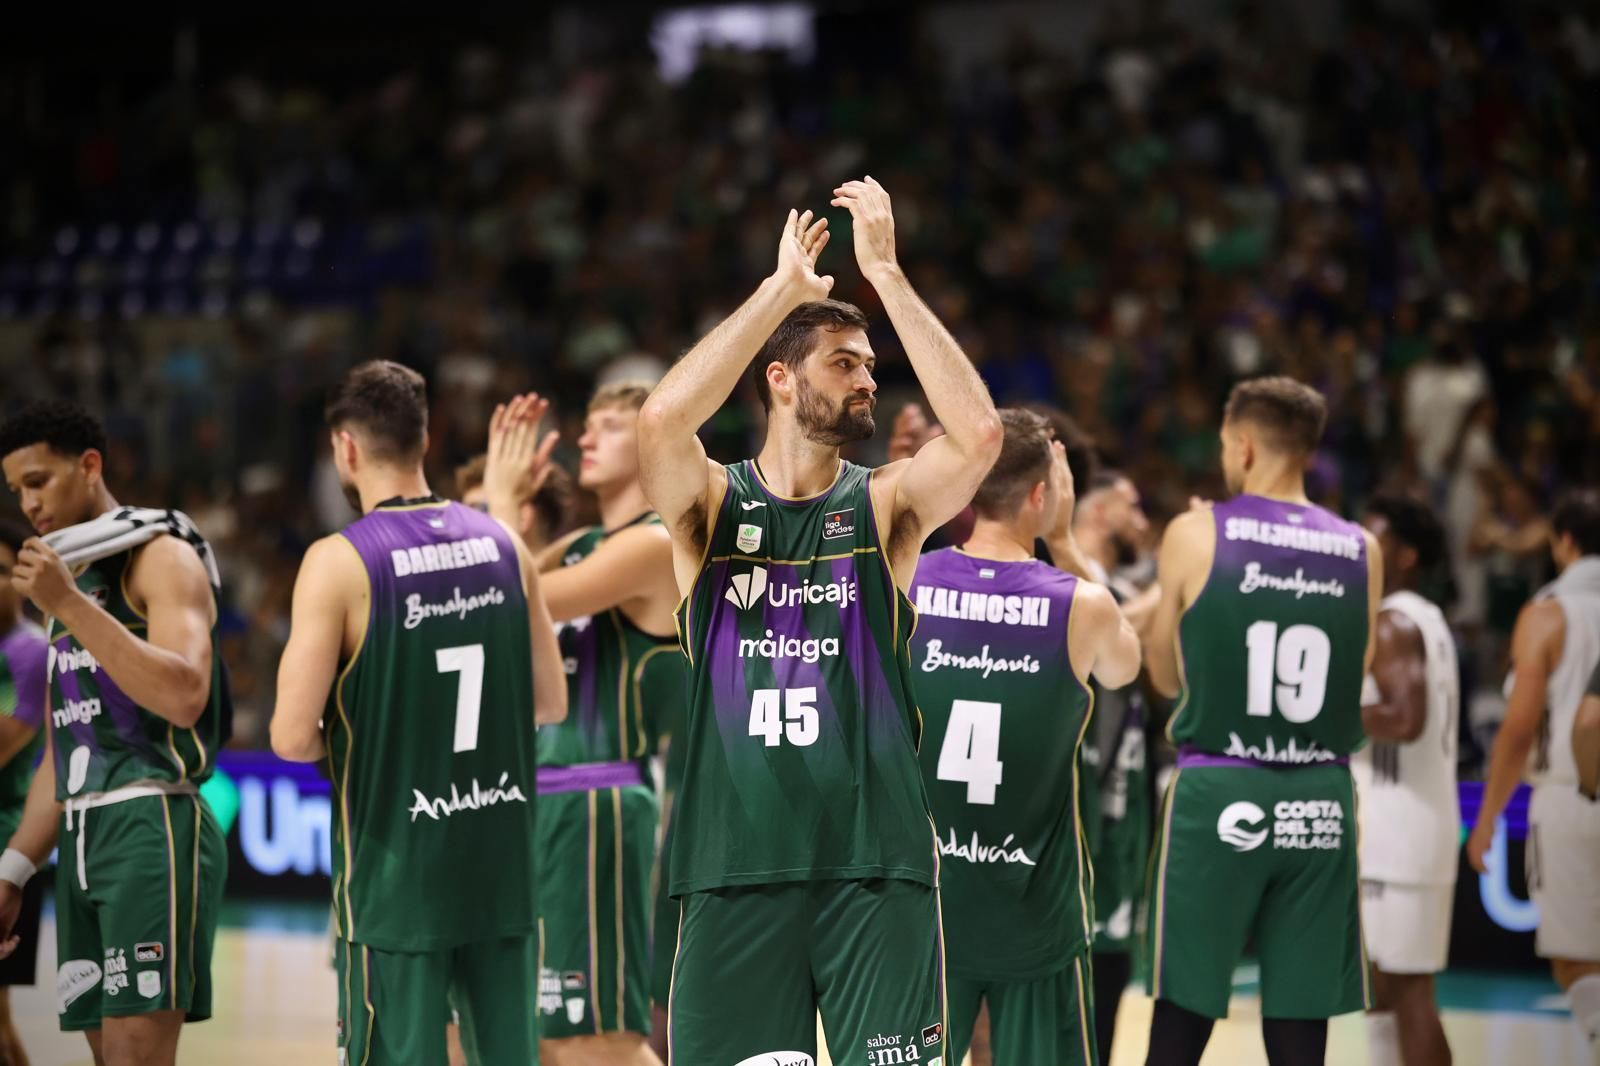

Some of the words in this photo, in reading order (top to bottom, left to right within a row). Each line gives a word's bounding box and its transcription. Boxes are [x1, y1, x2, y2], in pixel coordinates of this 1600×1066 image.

[391, 536, 500, 577] BARREIRO
[916, 585, 1050, 627] KALINOSKI
[1246, 620, 1331, 723] 19
[435, 643, 485, 753] 7
[748, 686, 820, 747] 45
[936, 699, 1003, 805] 4
[408, 771, 528, 823] Andalucía
[1273, 800, 1344, 819] COSTA
[936, 826, 1037, 866] ndalucía
[1273, 819, 1310, 835] DEL
[1311, 818, 1344, 835] SOL
[866, 1033, 902, 1048] sabor
[867, 1050, 876, 1060] a
[875, 1036, 922, 1066] má
[925, 1032, 939, 1044] acb
